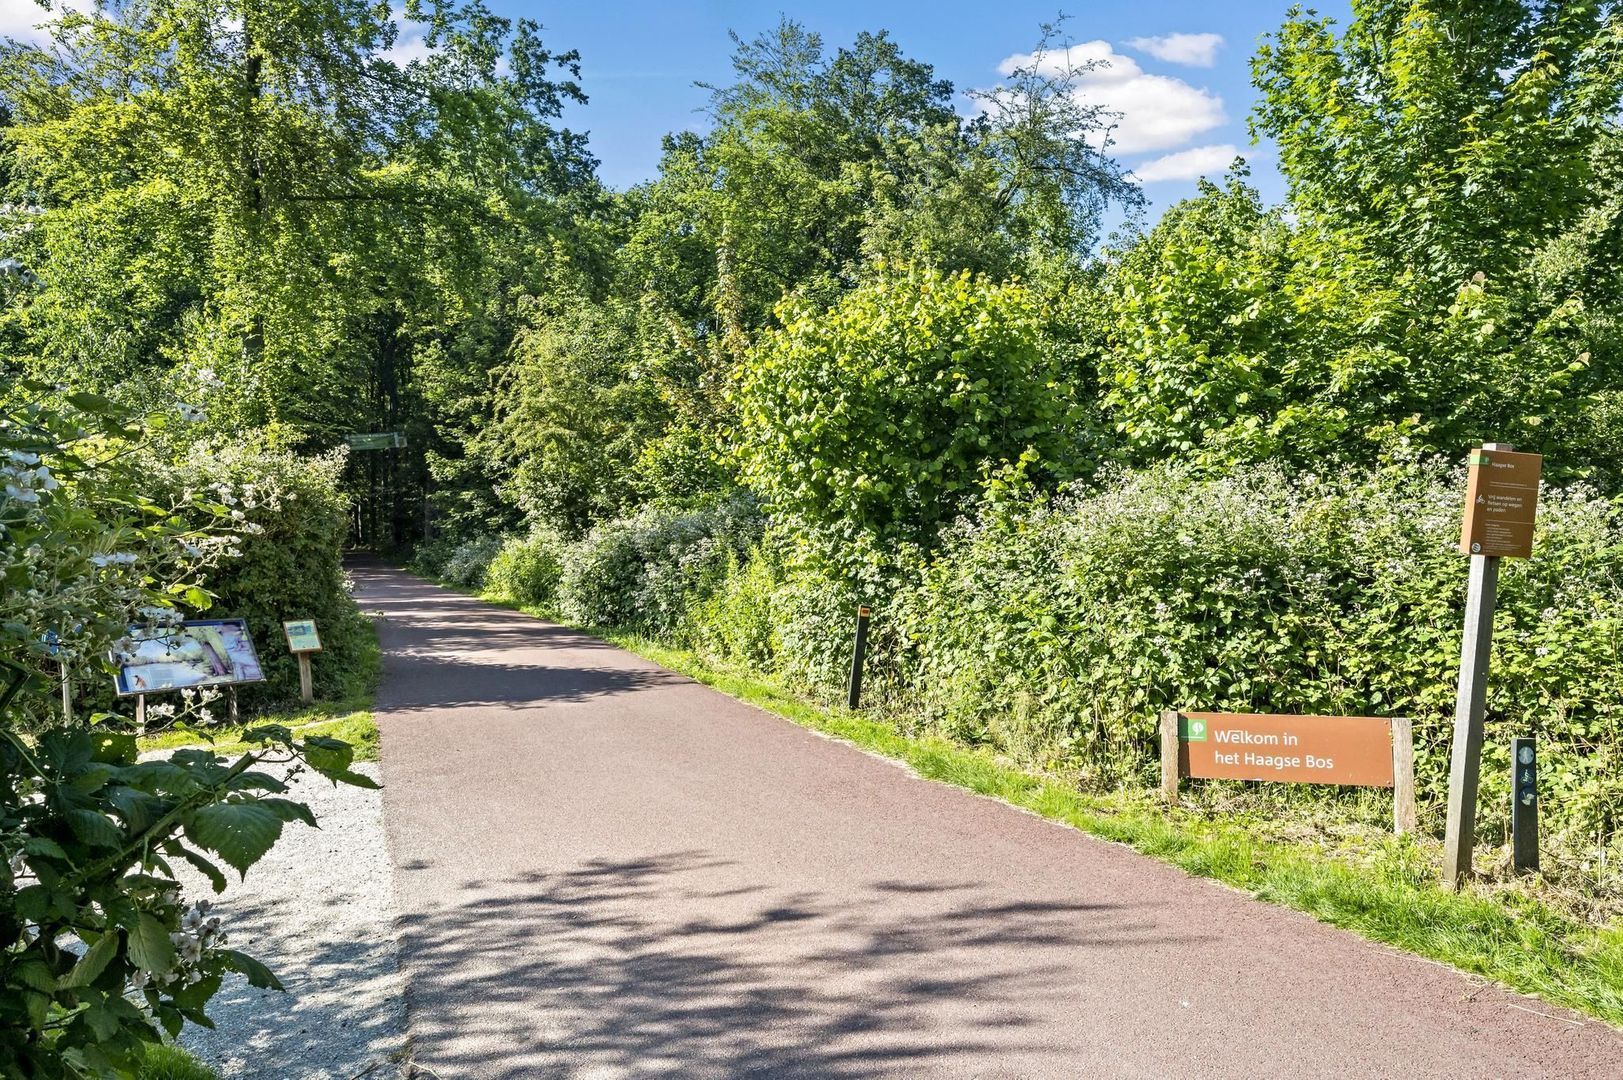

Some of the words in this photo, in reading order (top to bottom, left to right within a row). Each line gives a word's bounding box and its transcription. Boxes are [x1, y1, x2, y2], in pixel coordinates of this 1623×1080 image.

[1214, 729, 1278, 745] Welkom
[1283, 732, 1299, 746] in
[1214, 750, 1240, 765] het
[1244, 752, 1300, 770] Haagse
[1306, 754, 1334, 769] Bos
